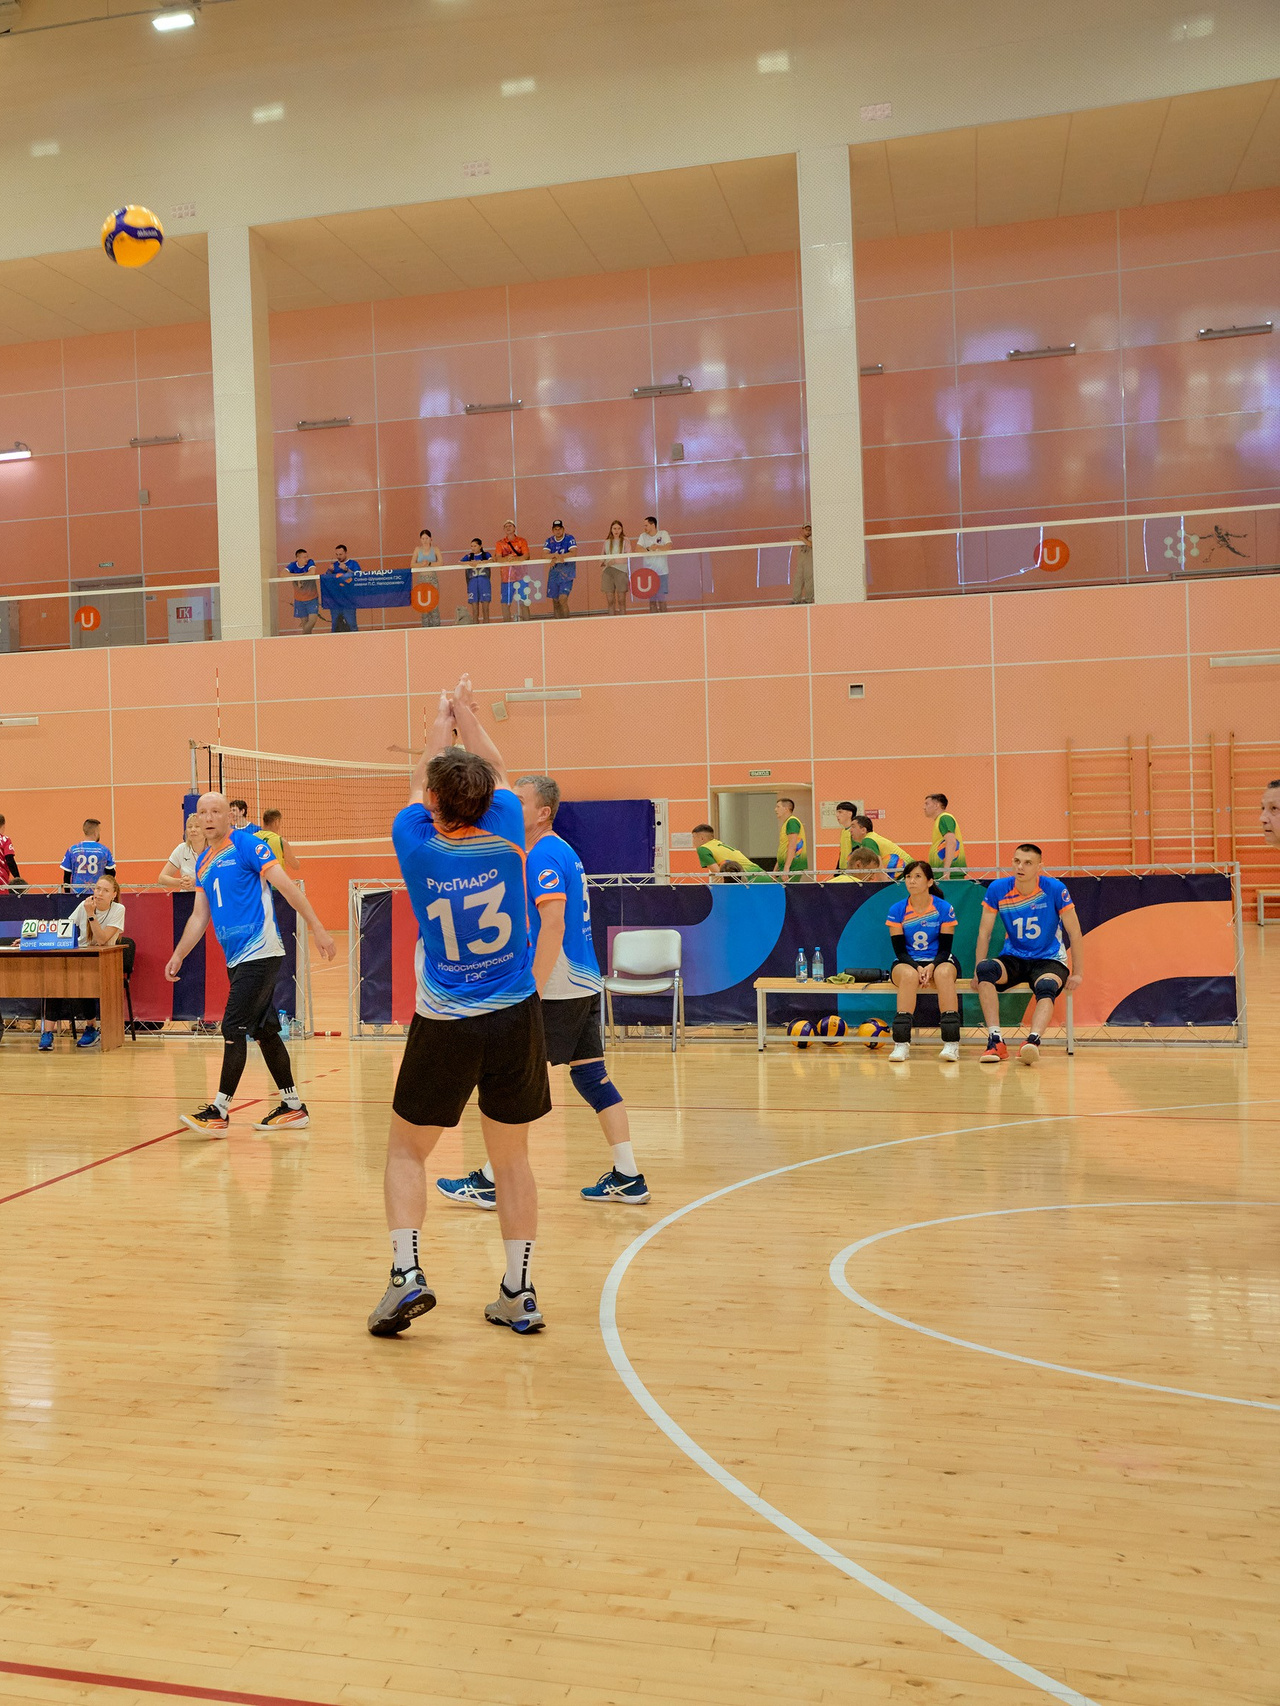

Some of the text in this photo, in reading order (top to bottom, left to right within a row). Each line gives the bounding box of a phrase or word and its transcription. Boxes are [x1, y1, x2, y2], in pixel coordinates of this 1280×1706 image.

[417, 590, 431, 606] U
[81, 613, 94, 627] U
[77, 855, 98, 874] 28
[426, 868, 499, 893] РусГидро
[213, 877, 223, 908] 1
[23, 921, 37, 933] 20
[61, 922, 70, 935] 7
[426, 880, 513, 962] 13
[1012, 916, 1042, 940] 15
[913, 931, 929, 951] 8
[437, 951, 514, 972] Новосибирская
[465, 970, 487, 983] ГЭС
